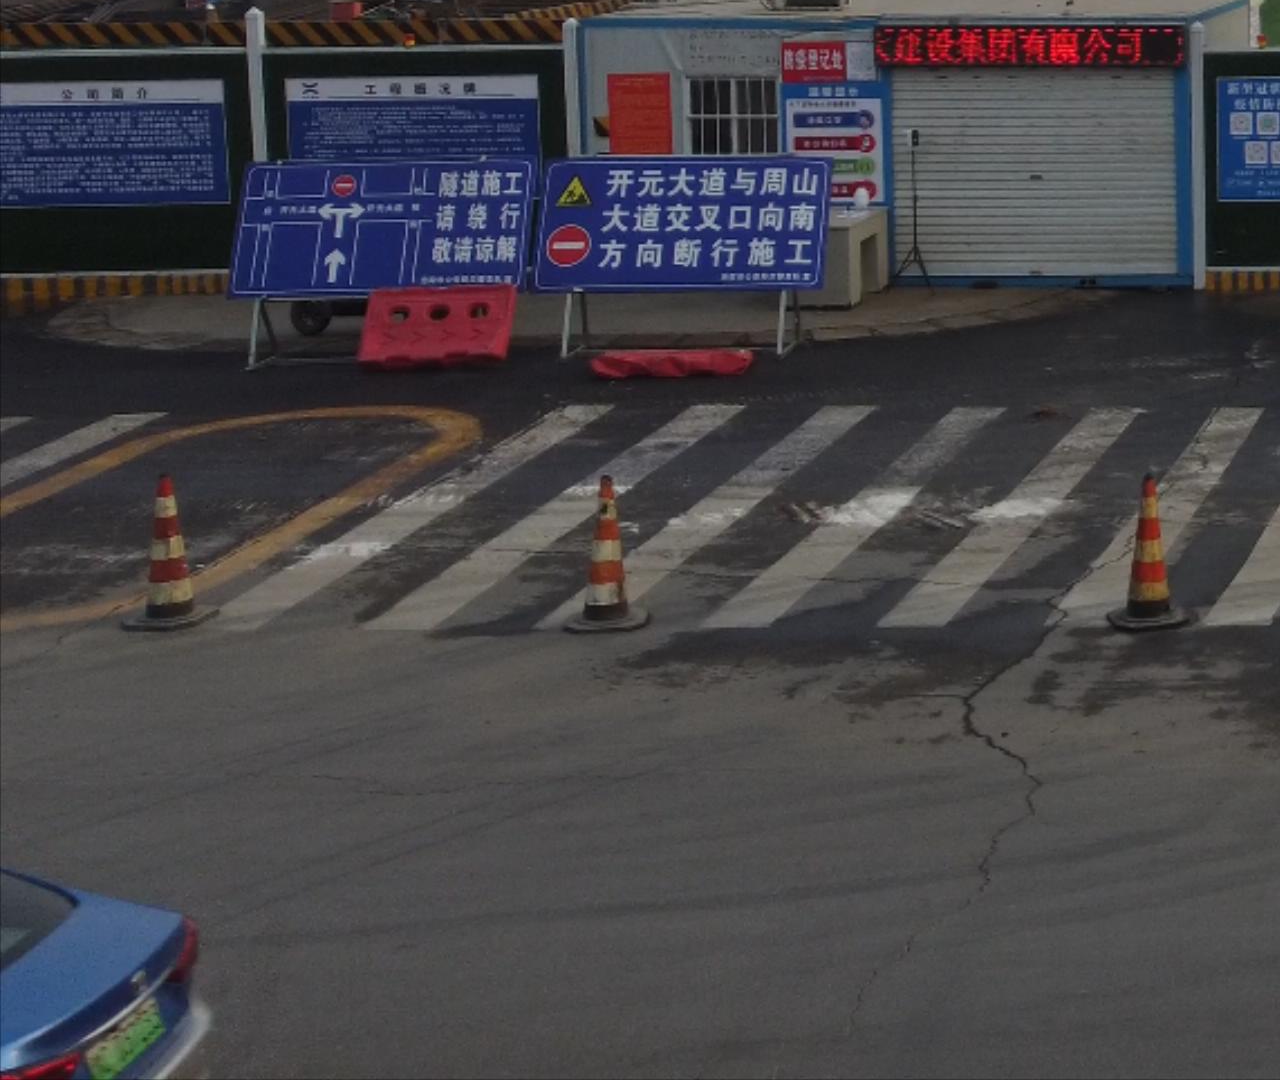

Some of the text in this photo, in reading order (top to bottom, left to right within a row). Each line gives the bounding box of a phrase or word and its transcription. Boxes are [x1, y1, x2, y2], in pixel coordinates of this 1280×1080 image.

[438, 171, 523, 198] 隧道施工
[606, 168, 819, 197] 开元大道与周山
[435, 203, 521, 231] 请绕行
[601, 204, 817, 232] 大道交叉口向南
[431, 236, 518, 263] 敬请谅解
[598, 239, 813, 268] 方向断行施工
